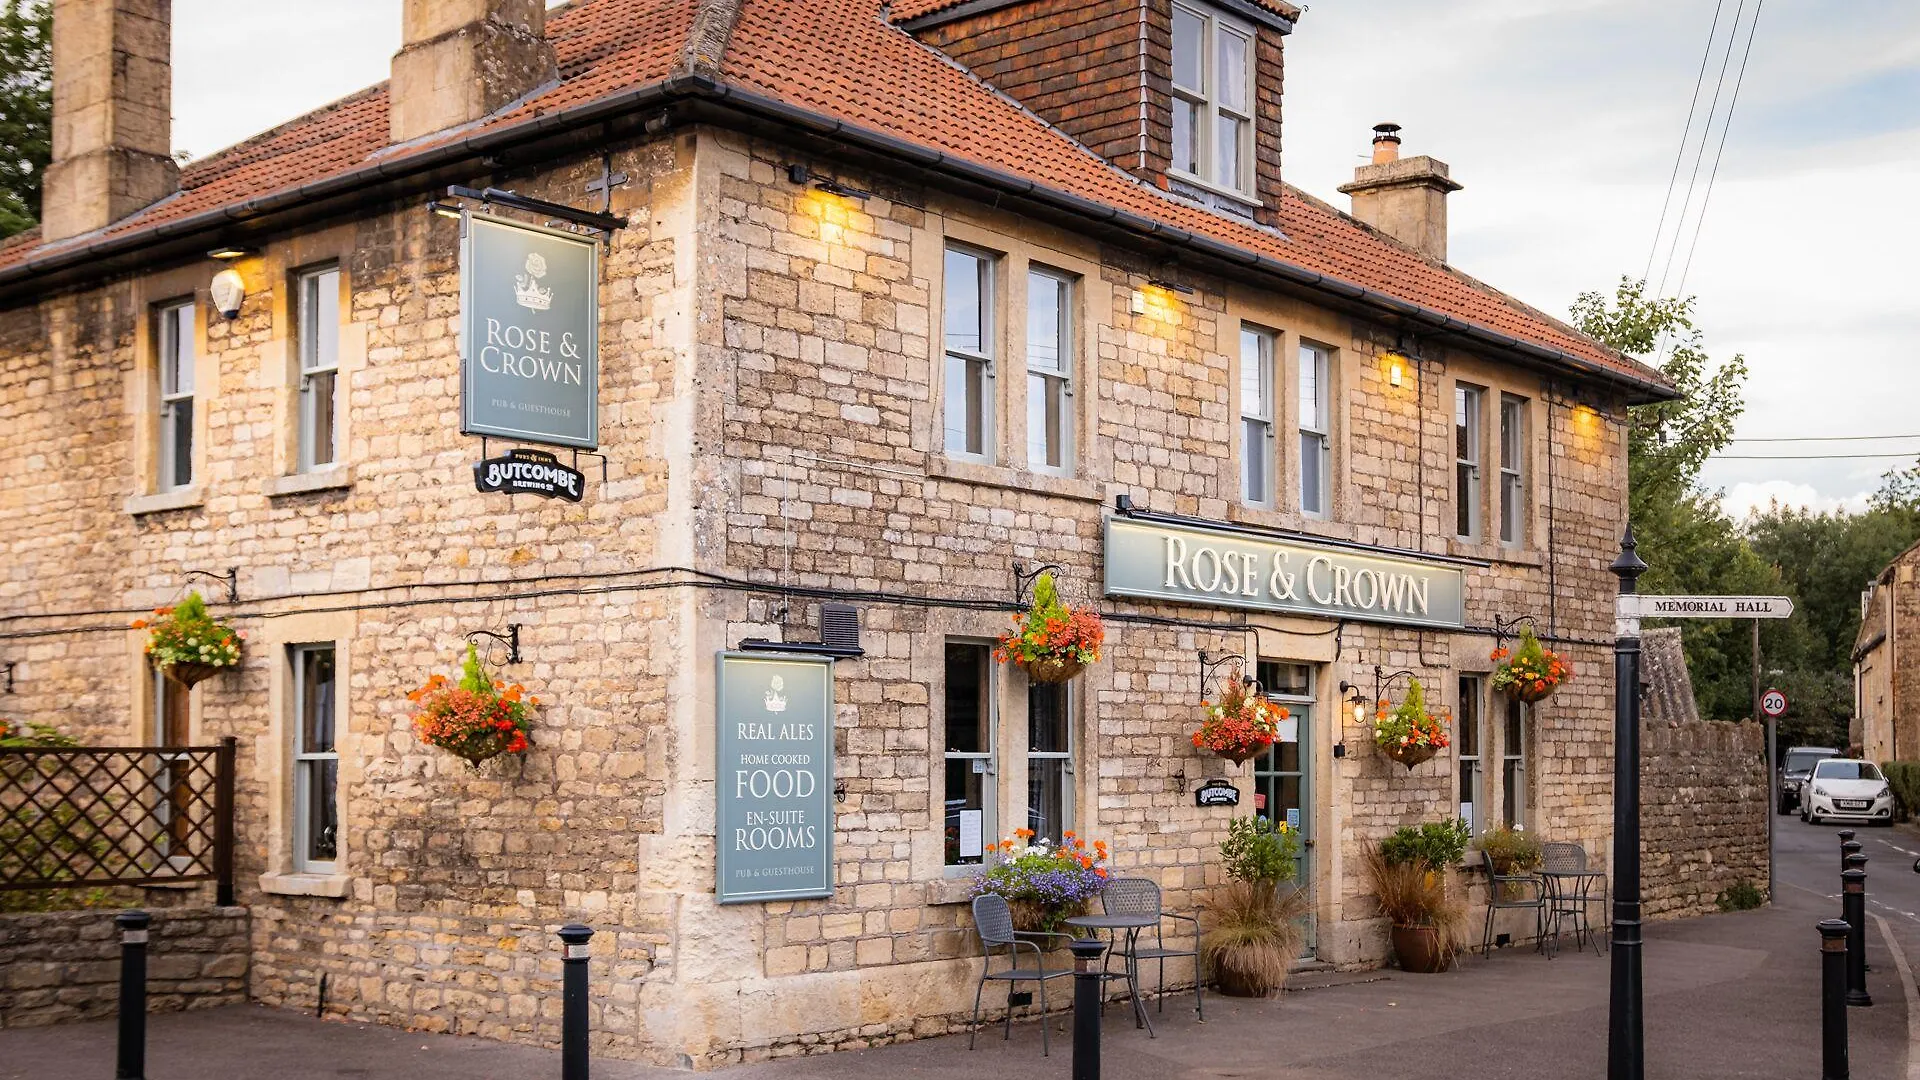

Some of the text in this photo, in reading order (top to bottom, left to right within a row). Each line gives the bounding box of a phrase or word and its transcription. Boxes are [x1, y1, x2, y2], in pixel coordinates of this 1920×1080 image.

[486, 317, 581, 359] ROSE &
[480, 346, 582, 386] CROWN
[491, 398, 508, 408] PUB
[518, 403, 571, 418] GUESTHOUSE
[485, 463, 578, 497] BUTCOMBE
[1162, 534, 1429, 616] ROSE & CROWN
[1655, 601, 1772, 613] MEMORIAL HALL
[1765, 698, 1783, 710] 20
[737, 722, 814, 740] REAL ALES
[740, 754, 810, 765] HOME COOKED
[735, 770, 815, 799] FOOD
[746, 810, 805, 826] EN-SUITE
[735, 825, 815, 851] ROOMS
[735, 865, 815, 878] PUB & GUESTHOUSE
